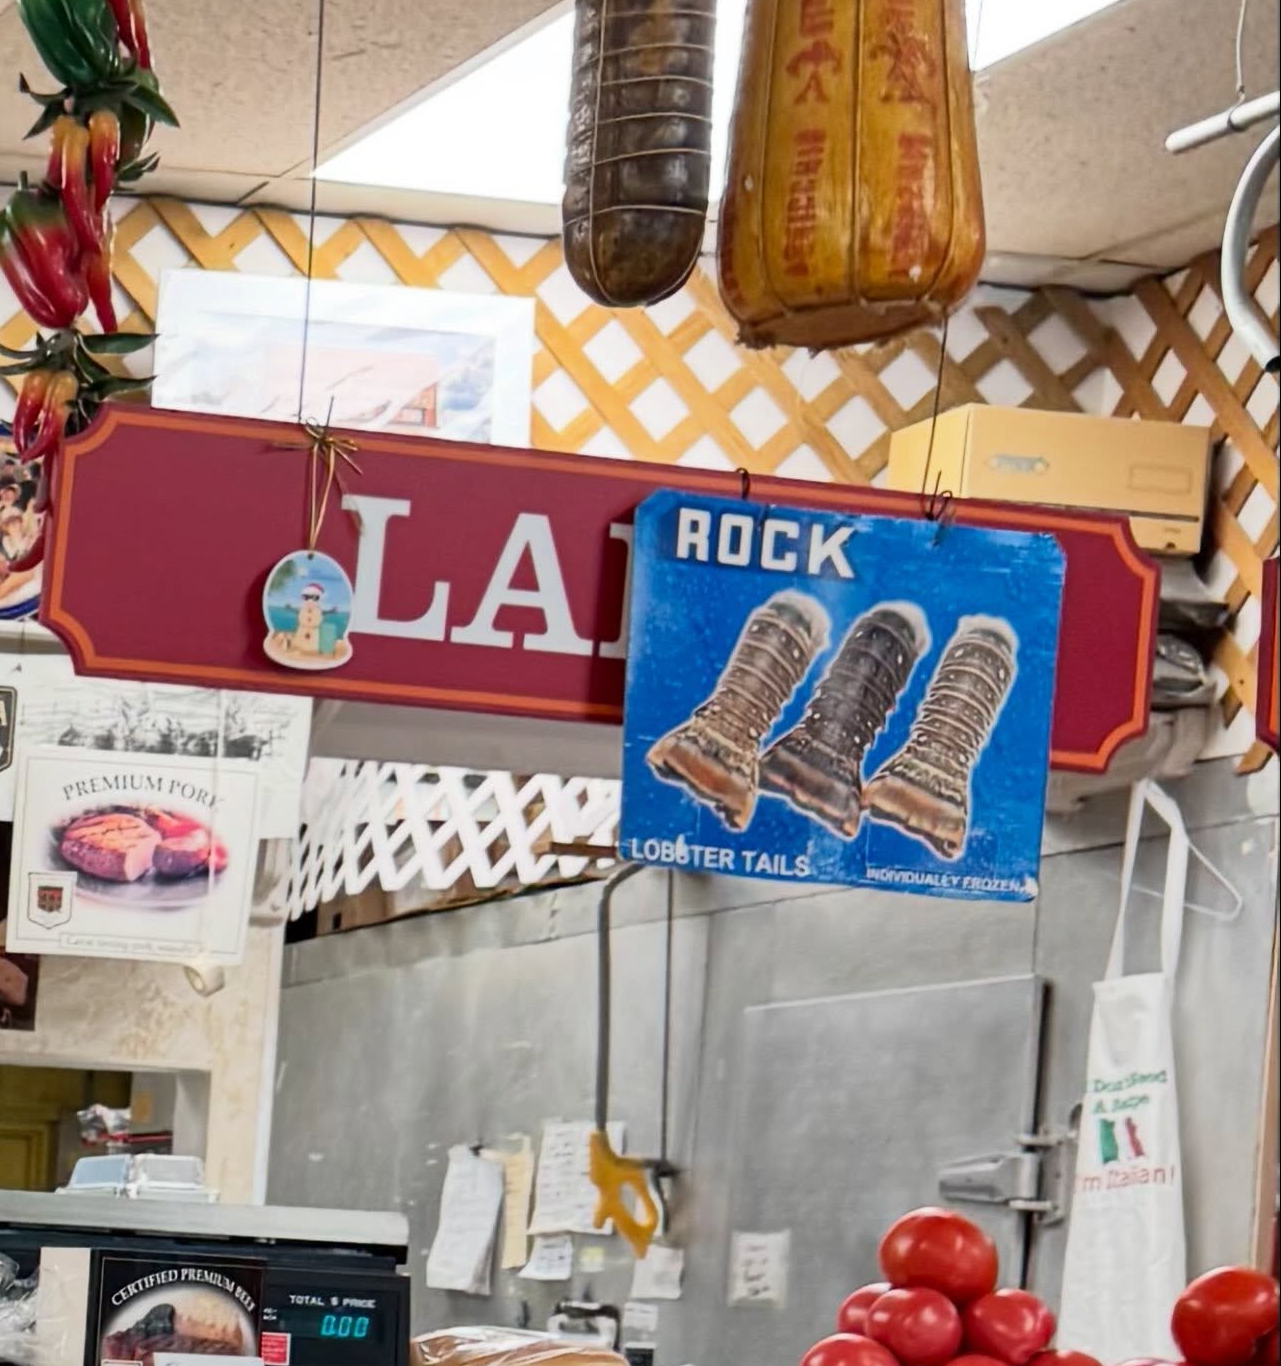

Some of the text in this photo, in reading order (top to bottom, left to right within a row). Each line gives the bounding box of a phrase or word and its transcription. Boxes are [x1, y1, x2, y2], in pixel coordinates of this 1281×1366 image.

[675, 508, 856, 580] ROCK
[63, 774, 225, 809] PREMIUM PORK
[630, 838, 811, 878] LOBSTER TAILS
[866, 867, 1021, 893] INDIVIDUALLY FROZEN
[111, 1268, 179, 1307] CERTIFIED
[180, 1267, 235, 1293] PREMIUM
[288, 1293, 325, 1307] TOTAL
[342, 1297, 377, 1309] PRICE
